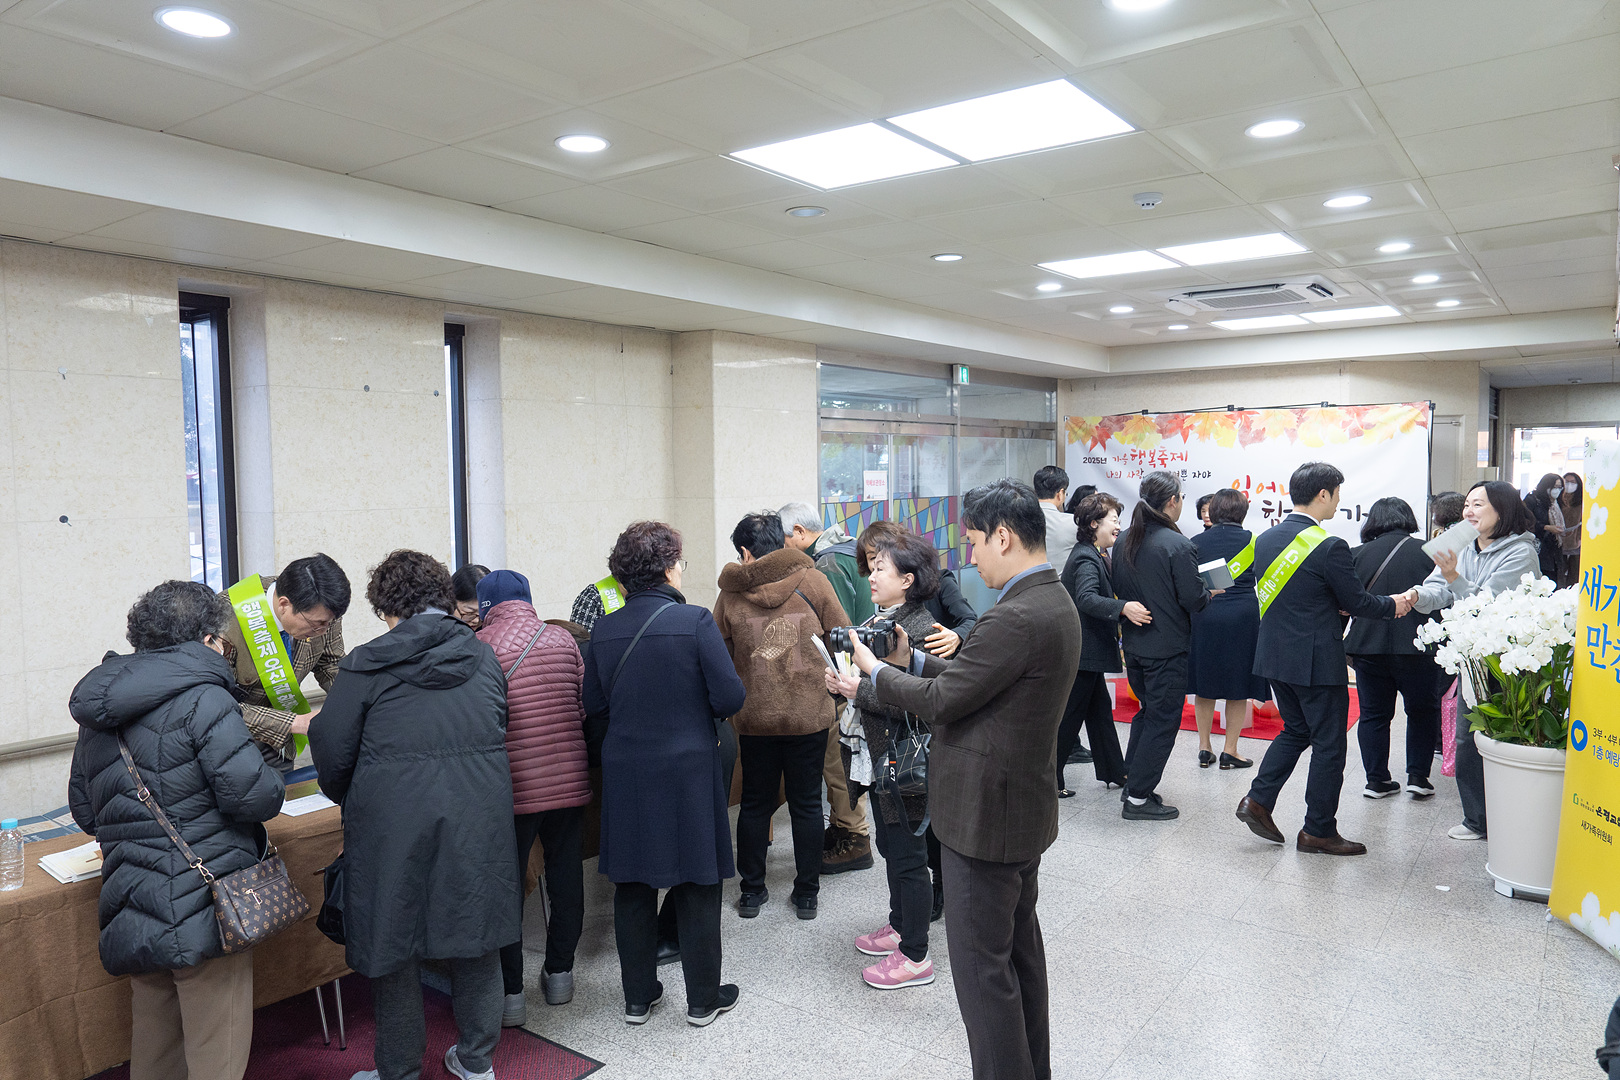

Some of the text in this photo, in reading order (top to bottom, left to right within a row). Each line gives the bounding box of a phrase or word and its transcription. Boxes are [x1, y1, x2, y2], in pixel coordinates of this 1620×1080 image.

[1112, 453, 1128, 465] 가을
[1130, 446, 1188, 468] 행복축제
[1106, 470, 1122, 479] 나의
[1192, 470, 1212, 479] 자야
